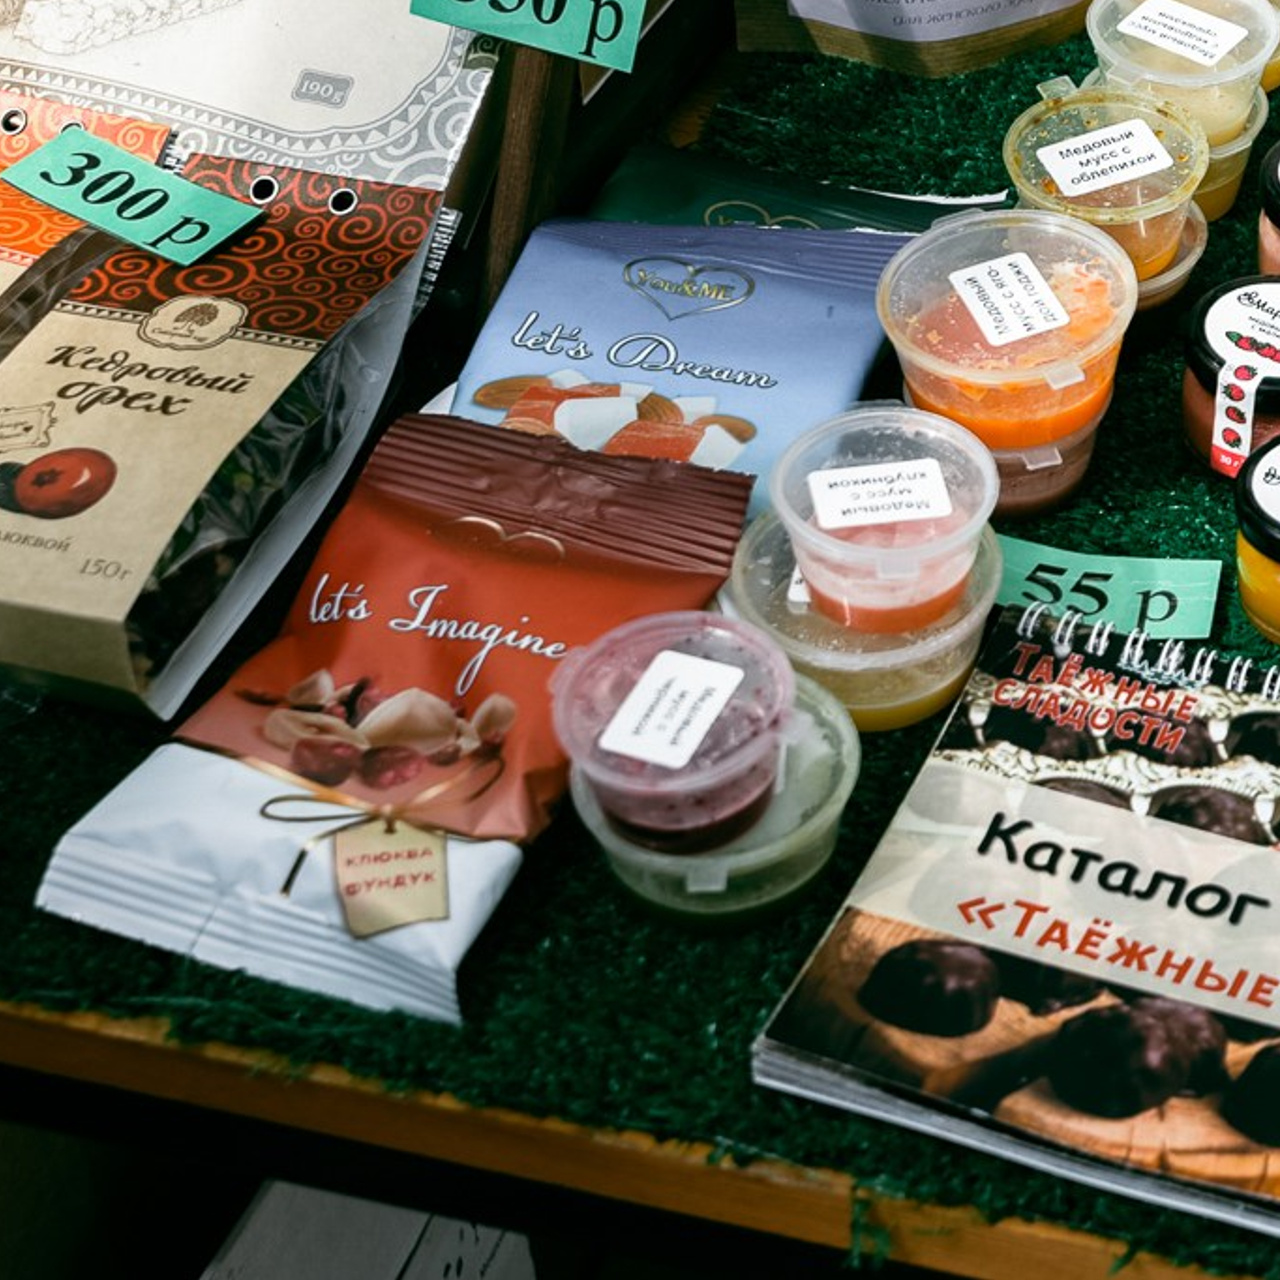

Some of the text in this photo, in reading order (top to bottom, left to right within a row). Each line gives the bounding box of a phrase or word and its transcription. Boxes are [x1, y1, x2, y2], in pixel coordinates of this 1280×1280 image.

[39, 152, 170, 221] 300
[1079, 148, 1119, 168] мусс
[45, 345, 255, 394] Кедровый
[607, 332, 778, 389] Dream
[1021, 562, 1115, 616] 55
[388, 584, 569, 696] Imagine
[1012, 640, 1198, 723] ТАЁЖНЫЕ
[993, 677, 1187, 754] СЛАДОСТИ
[344, 871, 436, 897] ФУНДУК
[347, 847, 434, 867] КЛЮКВА
[976, 811, 1271, 927] Каталог
[955, 902, 1280, 1019] «ТАЁЖНЫЕ
